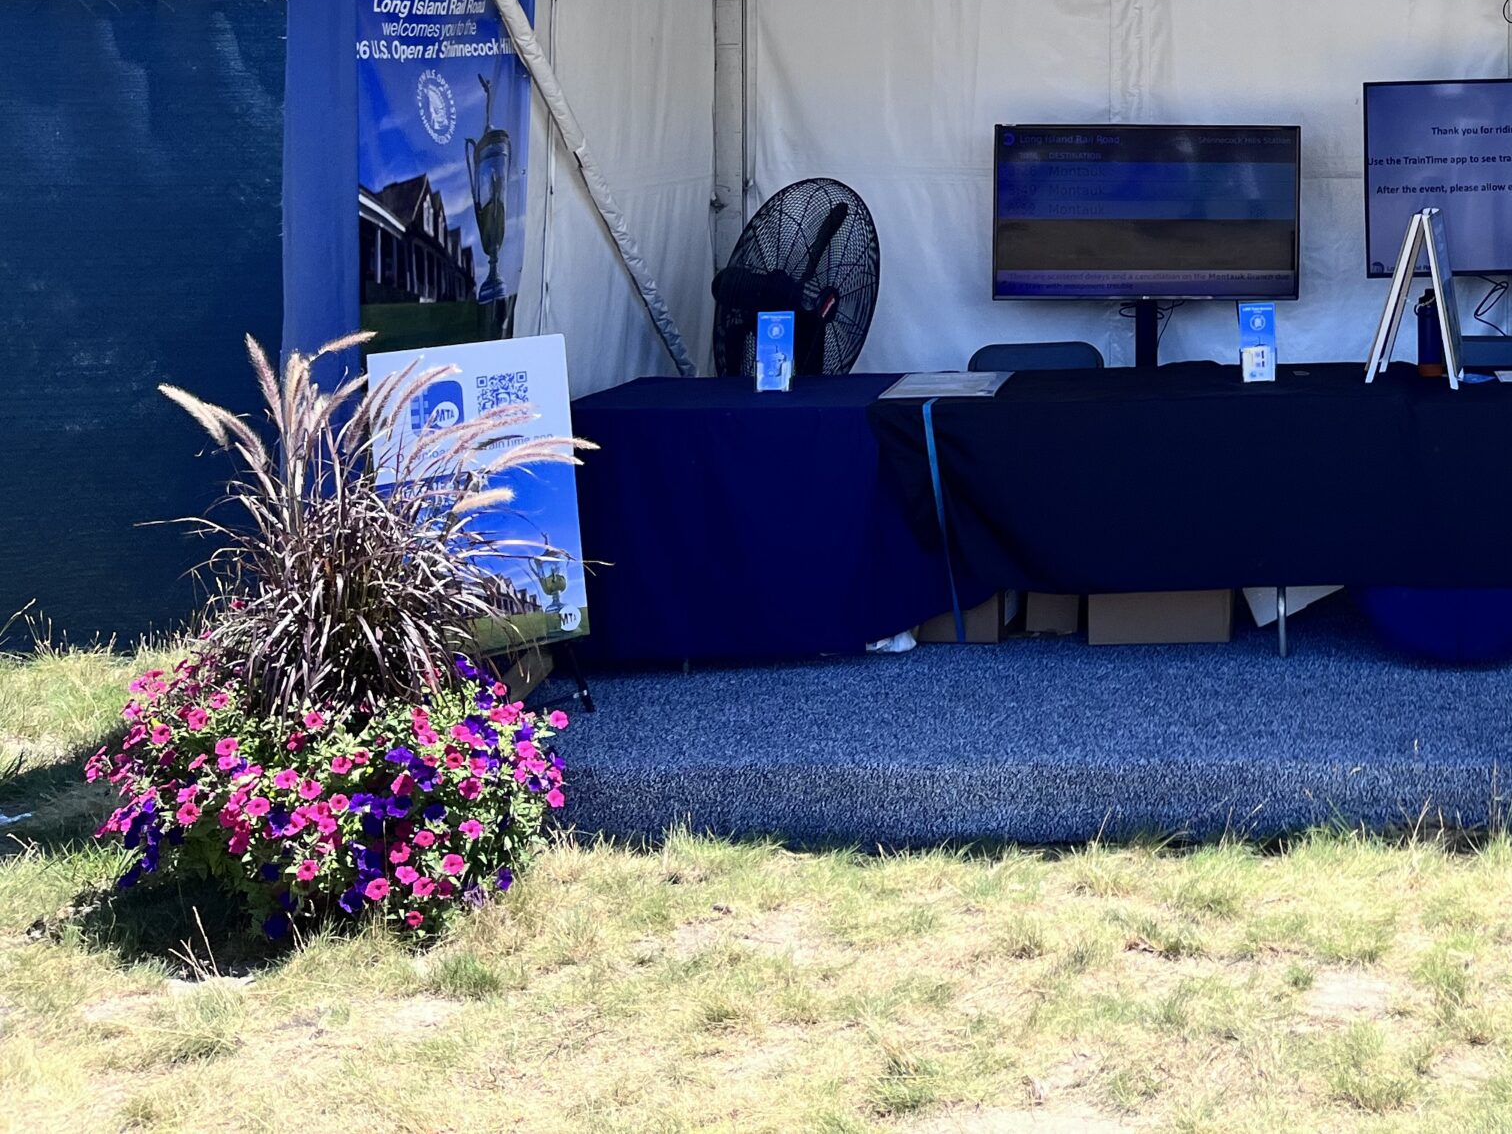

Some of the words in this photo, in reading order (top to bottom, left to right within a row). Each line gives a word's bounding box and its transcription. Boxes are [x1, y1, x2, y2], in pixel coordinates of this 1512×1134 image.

[382, 19, 440, 38] welcomes
[371, 40, 391, 60] U.S.
[392, 40, 424, 63] Open
[425, 42, 439, 59] at
[440, 37, 500, 59] Shinnecock
[1432, 126, 1460, 136] Thank
[1461, 127, 1479, 137] you
[1480, 125, 1494, 135] for
[1385, 156, 1402, 166] the
[1403, 155, 1448, 165] TrainTime
[1450, 157, 1468, 167] app
[1469, 155, 1479, 164] to
[1481, 156, 1497, 164] see
[1376, 185, 1400, 195] After
[1402, 185, 1417, 194] the
[1419, 186, 1448, 195] event,
[1449, 184, 1480, 194] please
[1481, 182, 1506, 192] allow
